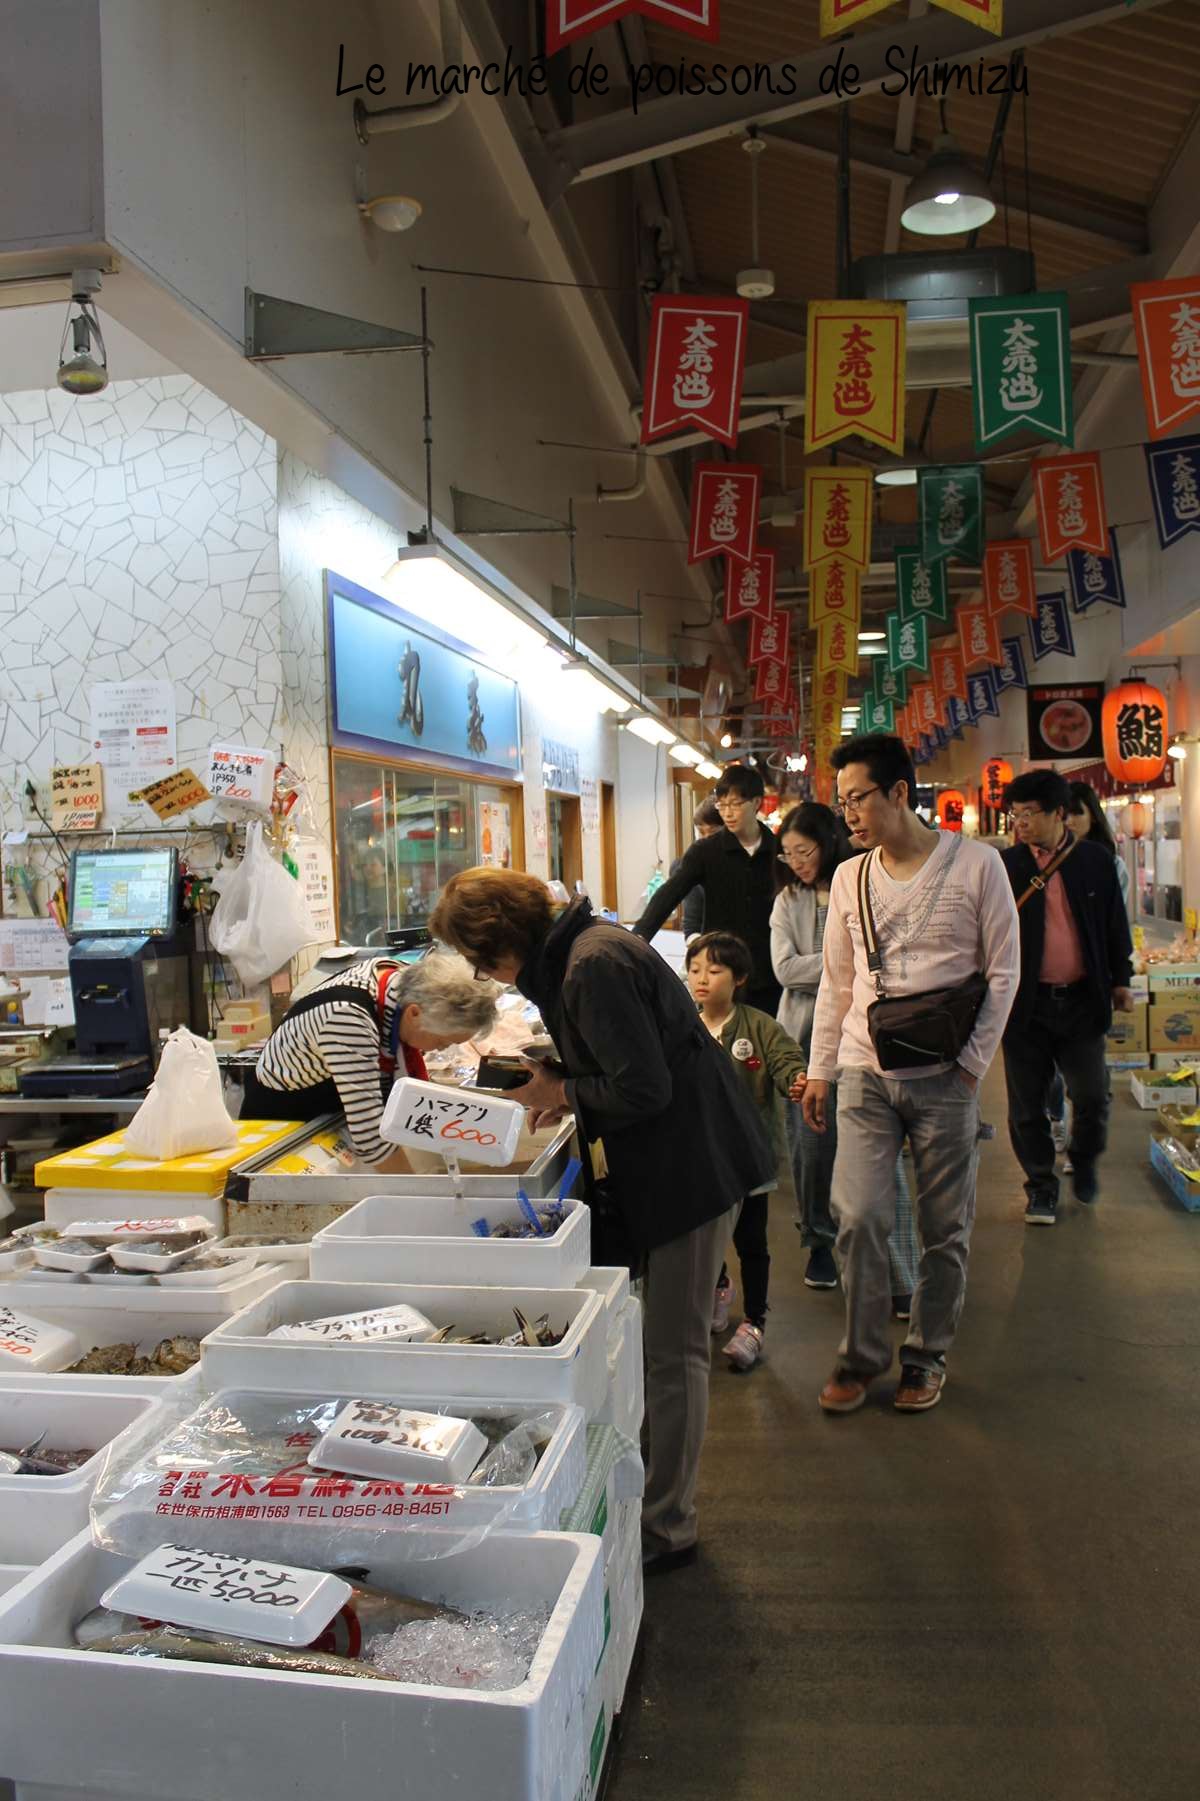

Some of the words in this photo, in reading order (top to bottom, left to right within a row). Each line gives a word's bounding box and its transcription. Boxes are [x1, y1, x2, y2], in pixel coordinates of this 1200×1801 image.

[1116, 703, 1163, 761] 鮨
[415, 1097, 488, 1121] ハマグリ
[296, 1505, 328, 1518] TEL
[333, 1502, 450, 1518] 0956-48-8451
[165, 1556, 297, 1588] カンパチ
